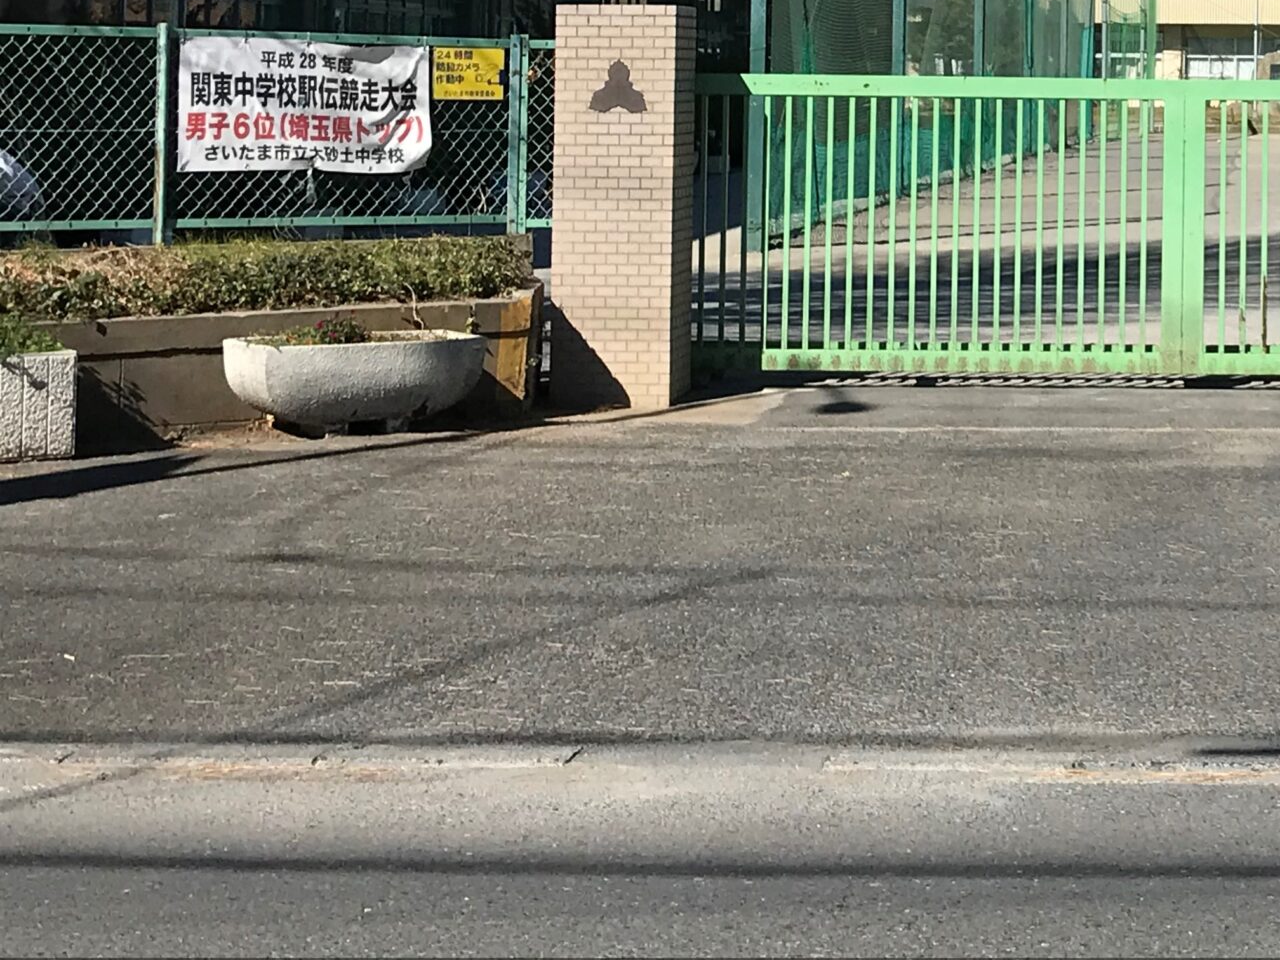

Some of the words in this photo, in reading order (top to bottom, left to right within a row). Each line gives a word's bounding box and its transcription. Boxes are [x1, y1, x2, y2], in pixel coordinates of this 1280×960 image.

[191, 72, 417, 111] 関東中学校駅伝競走大会
[205, 144, 405, 165] さいたま市立大砂土中学校
